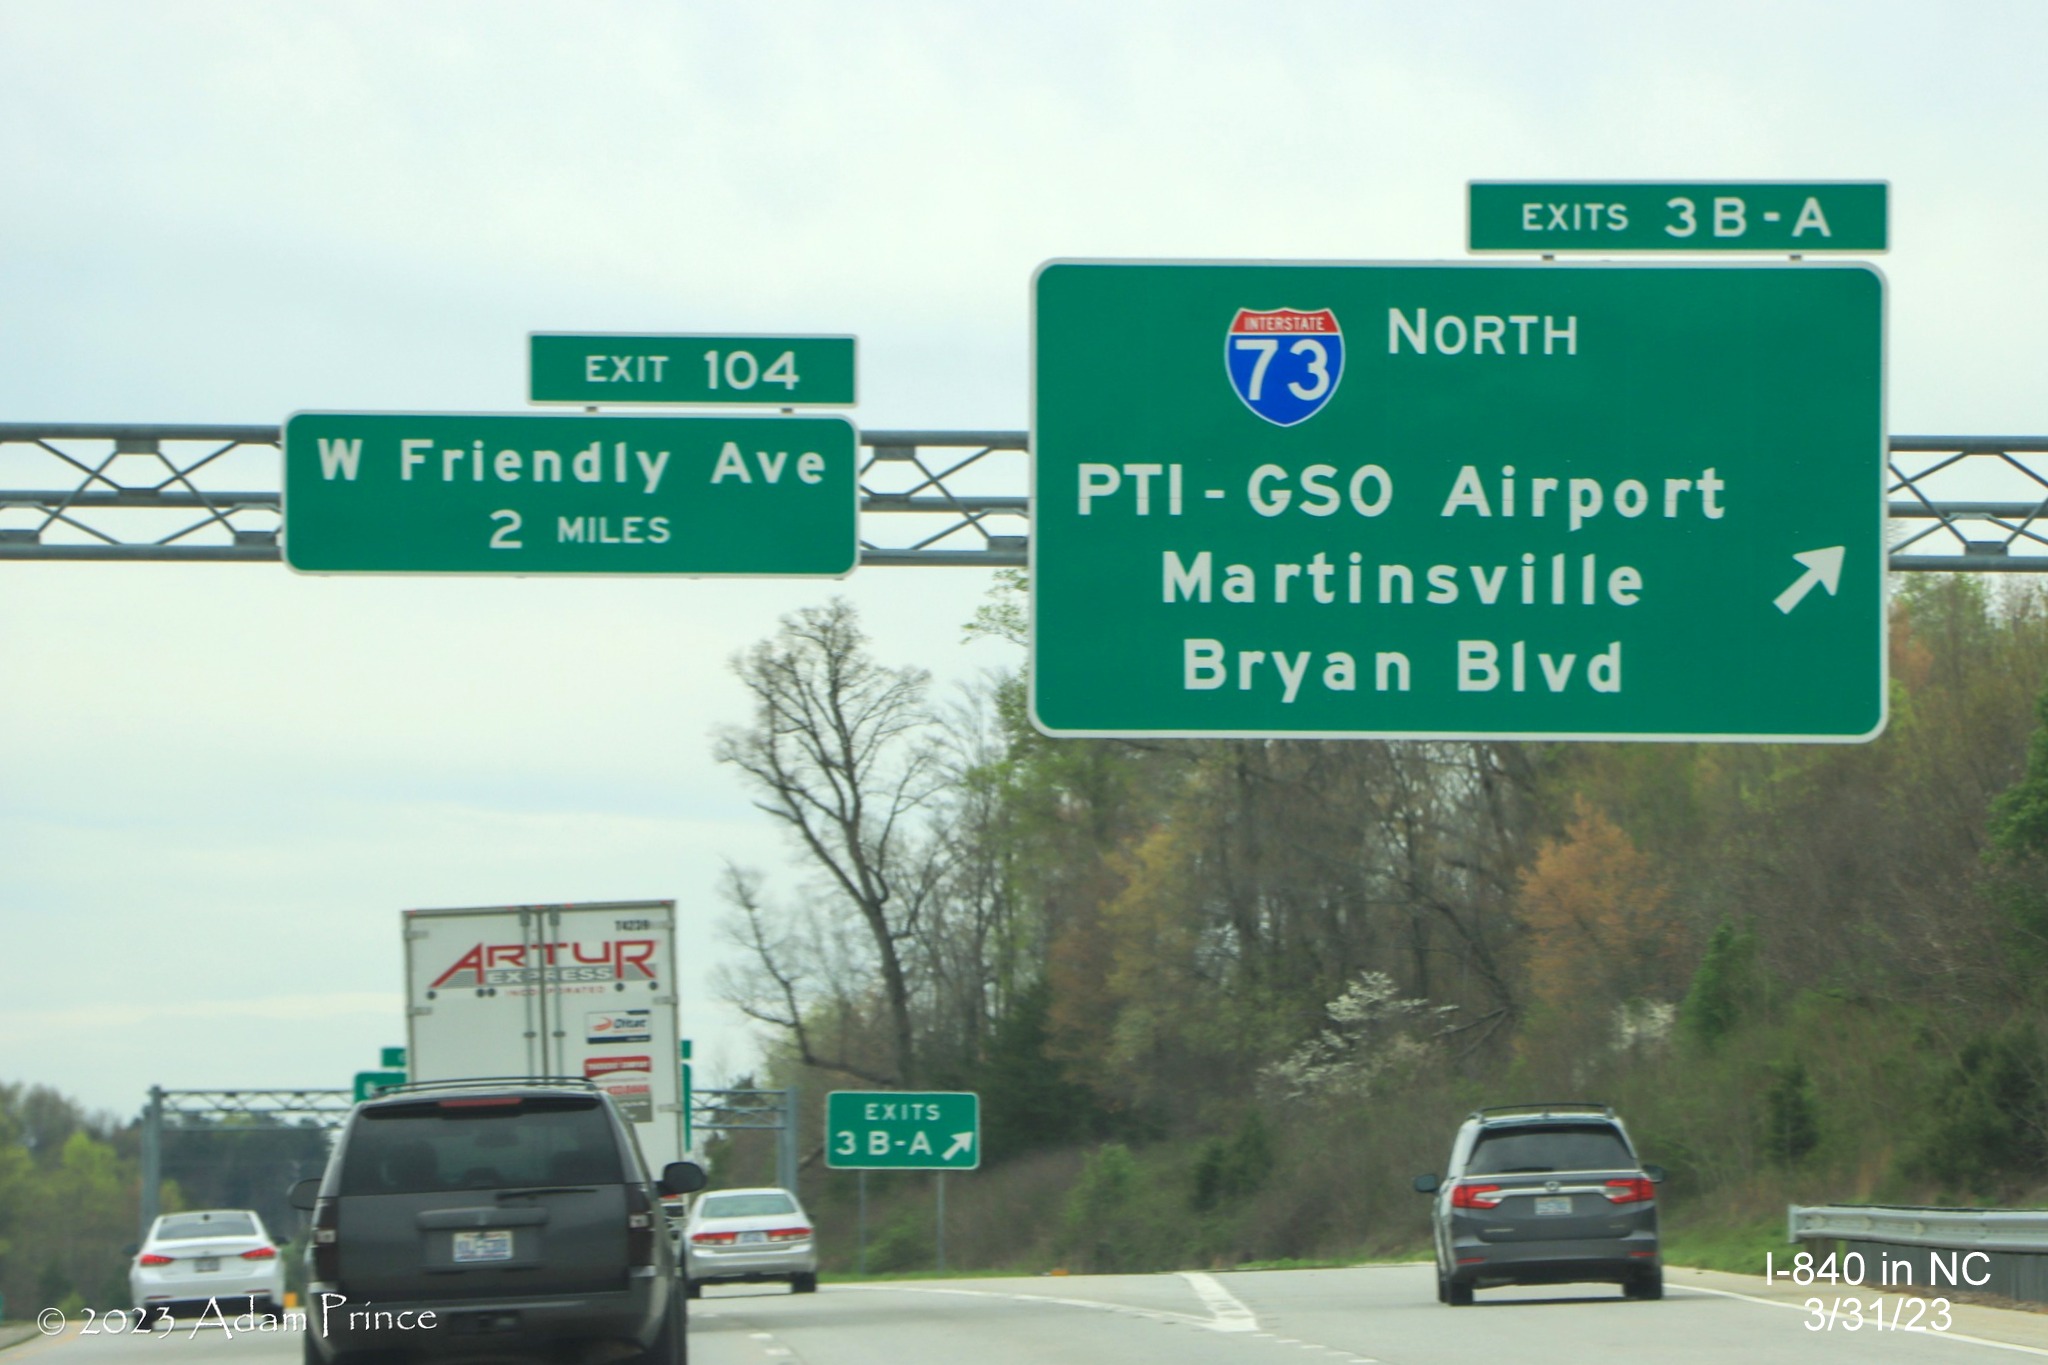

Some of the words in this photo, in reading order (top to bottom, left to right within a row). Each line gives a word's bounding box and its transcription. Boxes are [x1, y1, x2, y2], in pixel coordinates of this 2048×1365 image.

[1523, 203, 1628, 231] EXITS
[1244, 315, 1326, 332] INTERSTATE
[586, 355, 668, 382] EXIT
[704, 350, 799, 390] 104
[1235, 338, 1330, 401] 73
[318, 438, 362, 481] W
[401, 438, 670, 494] Friendly
[711, 441, 828, 485] Ave
[1441, 464, 1728, 532] Airport
[490, 509, 523, 549] 2
[558, 516, 671, 545] MILES
[1162, 550, 1644, 606] Martinsville
[1184, 638, 1411, 704] Bryan
[1457, 639, 1622, 694] Blvd
[430, 940, 656, 988] ARTUR
[864, 1103, 941, 1121] EXITS
